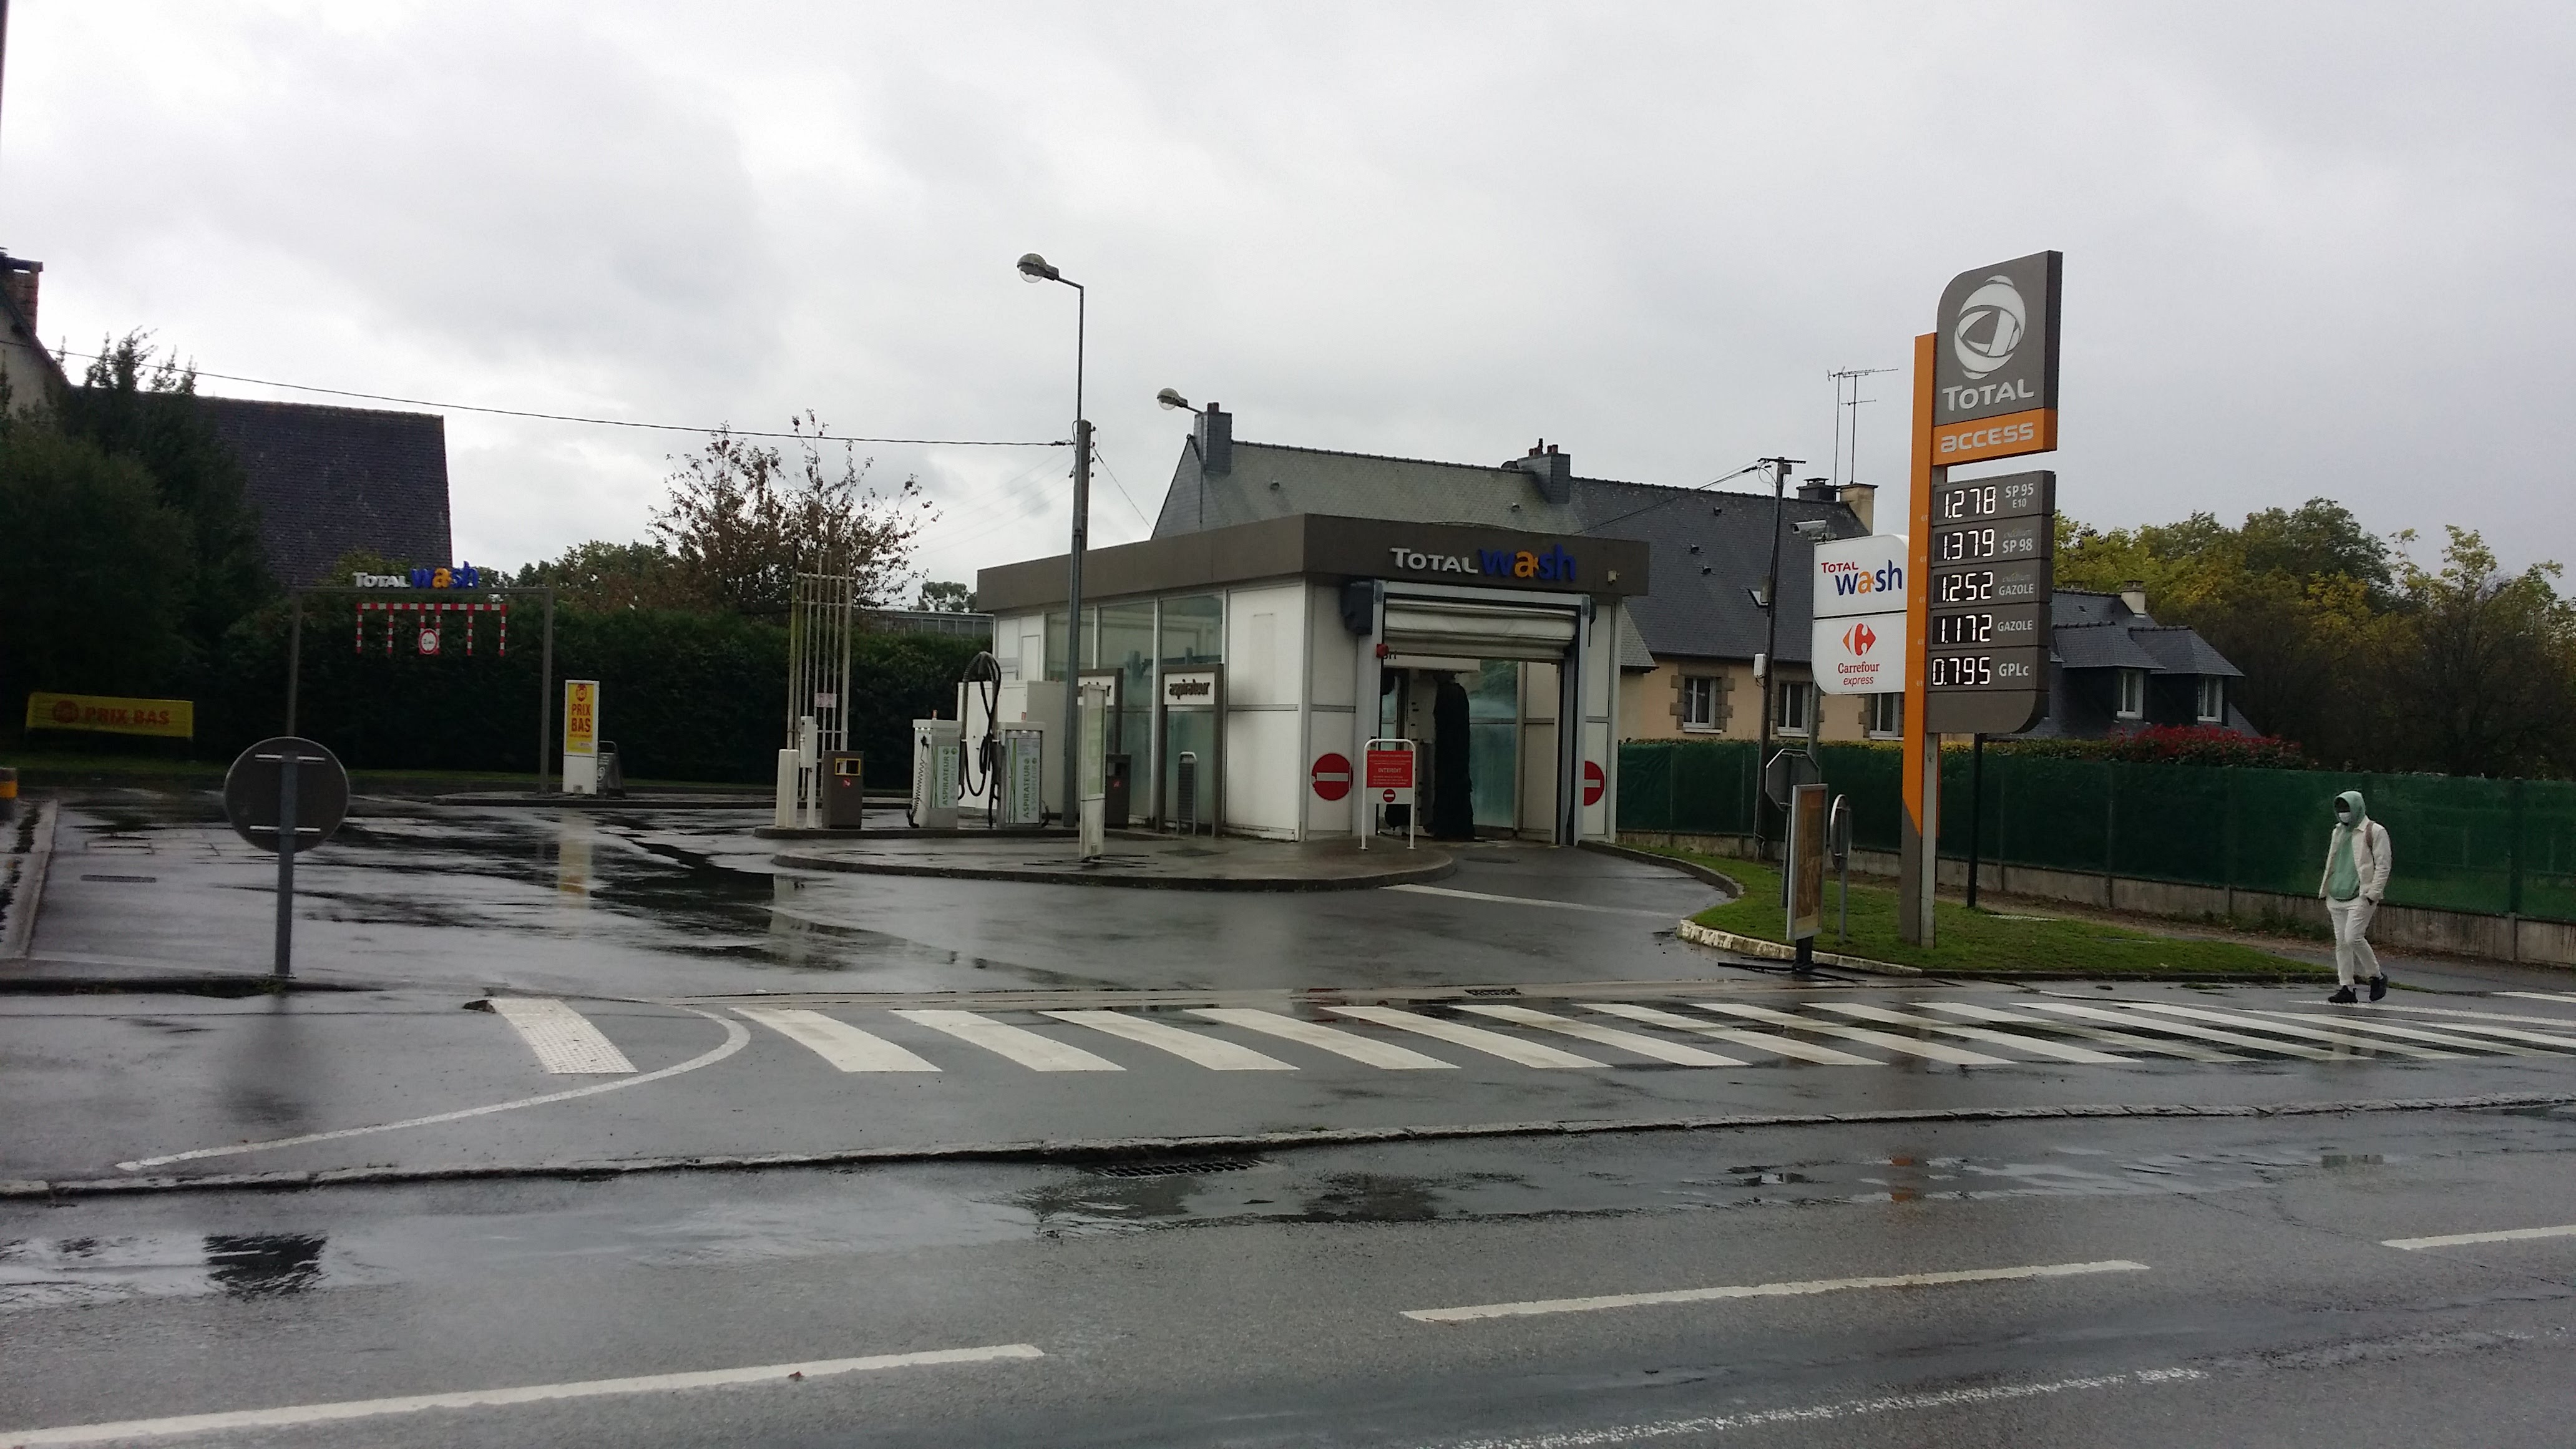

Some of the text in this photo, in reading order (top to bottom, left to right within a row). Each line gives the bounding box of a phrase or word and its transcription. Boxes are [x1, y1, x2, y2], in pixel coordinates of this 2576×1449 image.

[1942, 379, 2034, 411] TOTAL
[2005, 483, 2034, 499] SP 95
[1944, 485, 1996, 519] 1.278
[2012, 498, 2027, 509] E10
[1943, 529, 1994, 560] 1.379
[2002, 538, 2032, 554] SP 98
[1388, 543, 1577, 581] TOTAL wash
[1821, 561, 1859, 573] TOTAL
[353, 560, 480, 588] TOTAL wash
[1835, 559, 1903, 596] wash
[1942, 571, 1993, 602] 1.252
[1998, 583, 2034, 596] GAZOLE
[1941, 614, 1992, 643] 1.172
[1998, 620, 2032, 632] GAZOLE
[1838, 661, 1880, 674] Carrefour
[1933, 656, 1991, 685] 0.795
[1998, 663, 2029, 676] GPLc
[1843, 676, 1874, 686] express
[84, 706, 170, 726] PRIX BAS
[571, 704, 591, 716] PRIX
[571, 718, 591, 733] BAS
